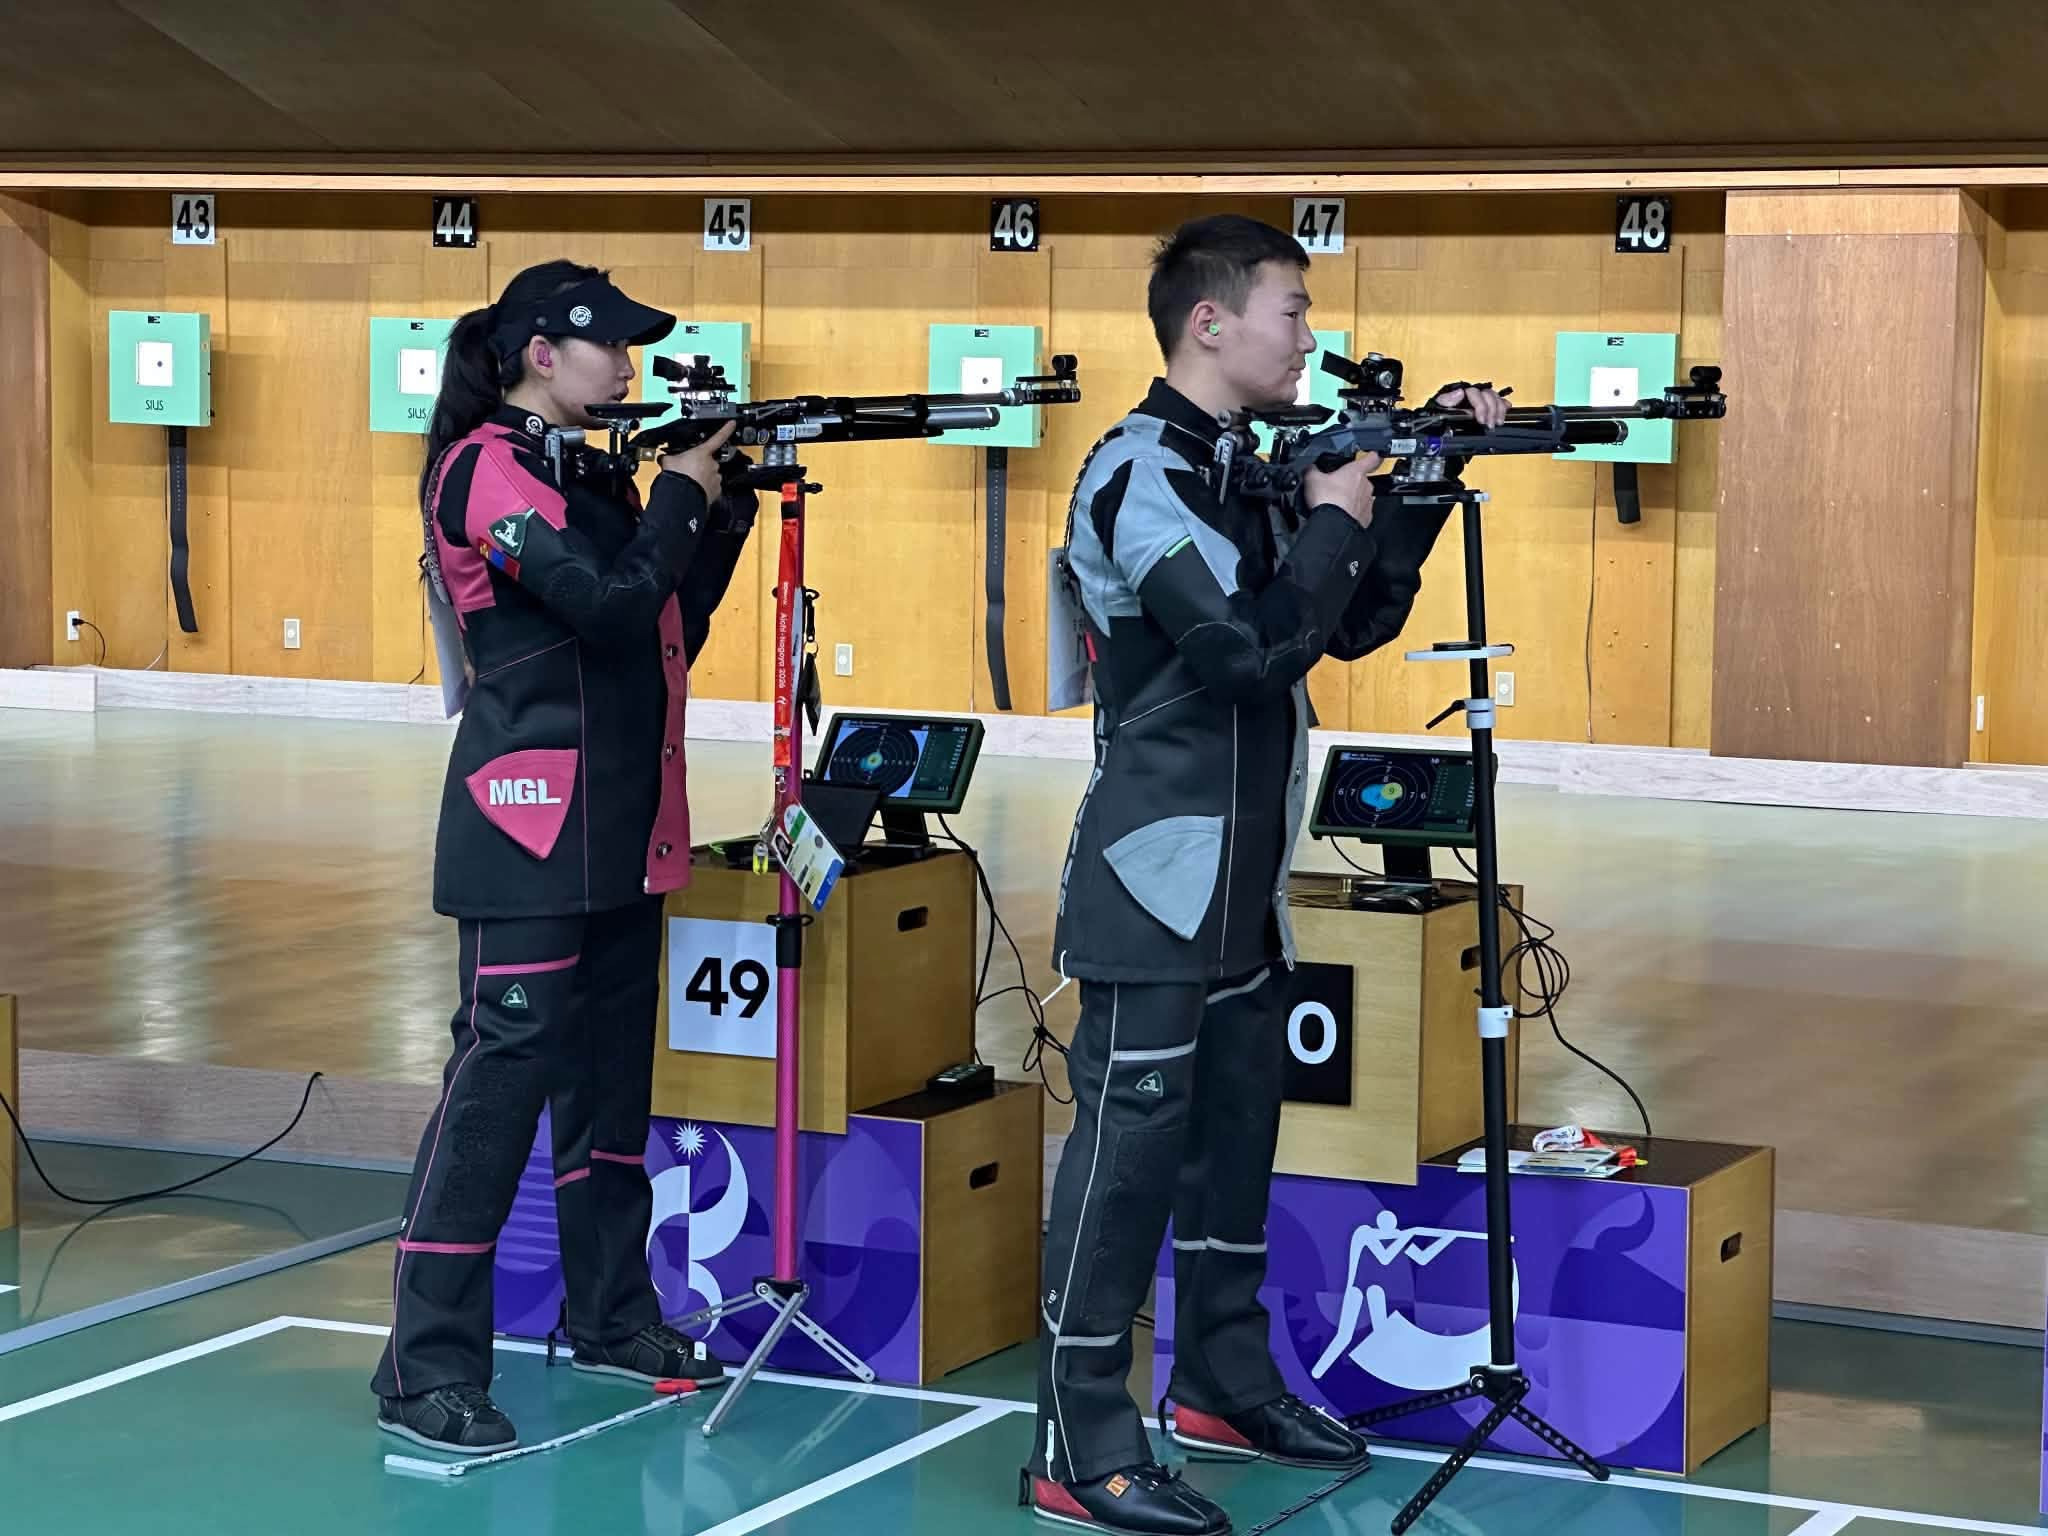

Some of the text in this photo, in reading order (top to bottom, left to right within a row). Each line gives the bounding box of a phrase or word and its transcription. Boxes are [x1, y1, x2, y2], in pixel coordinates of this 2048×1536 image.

[176, 199, 210, 239] 43
[435, 202, 473, 243] 44
[708, 203, 746, 244] 45
[993, 203, 1034, 247] 46
[1298, 204, 1340, 246] 47
[1619, 202, 1666, 248] 48
[145, 399, 164, 411] SIUS
[488, 778, 562, 806] MGL
[685, 957, 770, 1018] 49
[1287, 1001, 1337, 1065] 0
